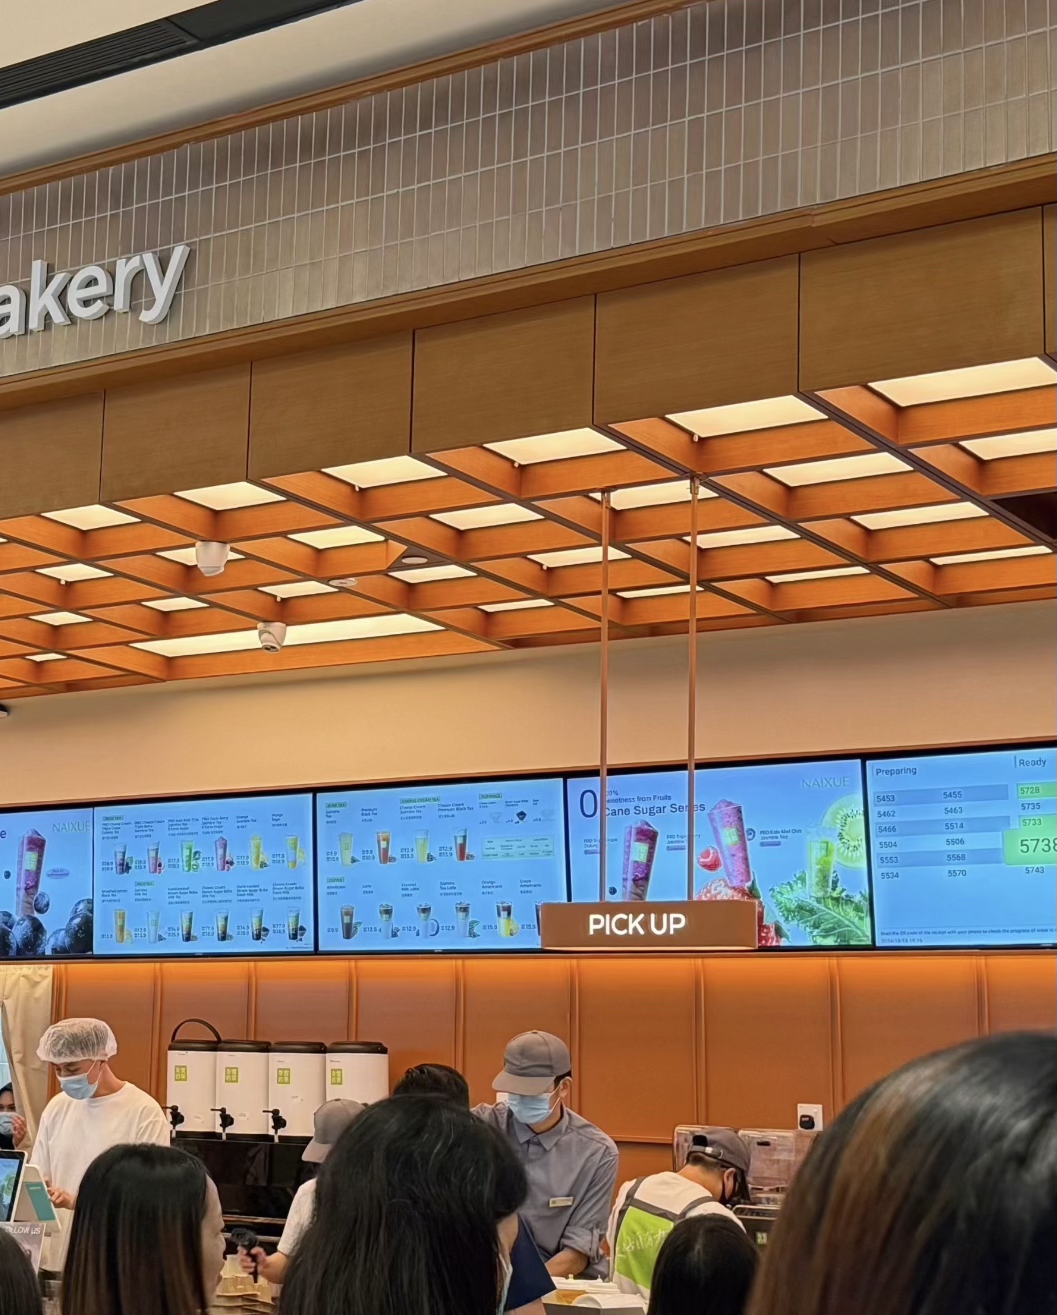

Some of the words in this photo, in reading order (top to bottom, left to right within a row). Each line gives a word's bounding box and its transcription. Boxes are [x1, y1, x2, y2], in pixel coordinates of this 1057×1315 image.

[1019, 755, 1047, 767] Ready
[876, 766, 917, 776] Preparing
[802, 777, 849, 788] NAIXUE
[1020, 786, 1040, 794] 5728
[876, 794, 895, 802] 5453
[943, 791, 962, 799] 5455
[580, 789, 598, 818] 0
[1021, 802, 1041, 810] 5735
[633, 804, 666, 816] Sugar
[670, 803, 706, 813] Seres
[944, 806, 963, 814] 5463
[944, 822, 964, 830] 5514
[1022, 818, 1042, 826] 5733
[52, 821, 92, 832] NAIXUE
[946, 838, 964, 846] 5506
[946, 854, 966, 862] 5568
[948, 869, 966, 877] 5570
[1026, 866, 1044, 874] 5743
[588, 913, 646, 935] PICK
[649, 912, 686, 935] UP
